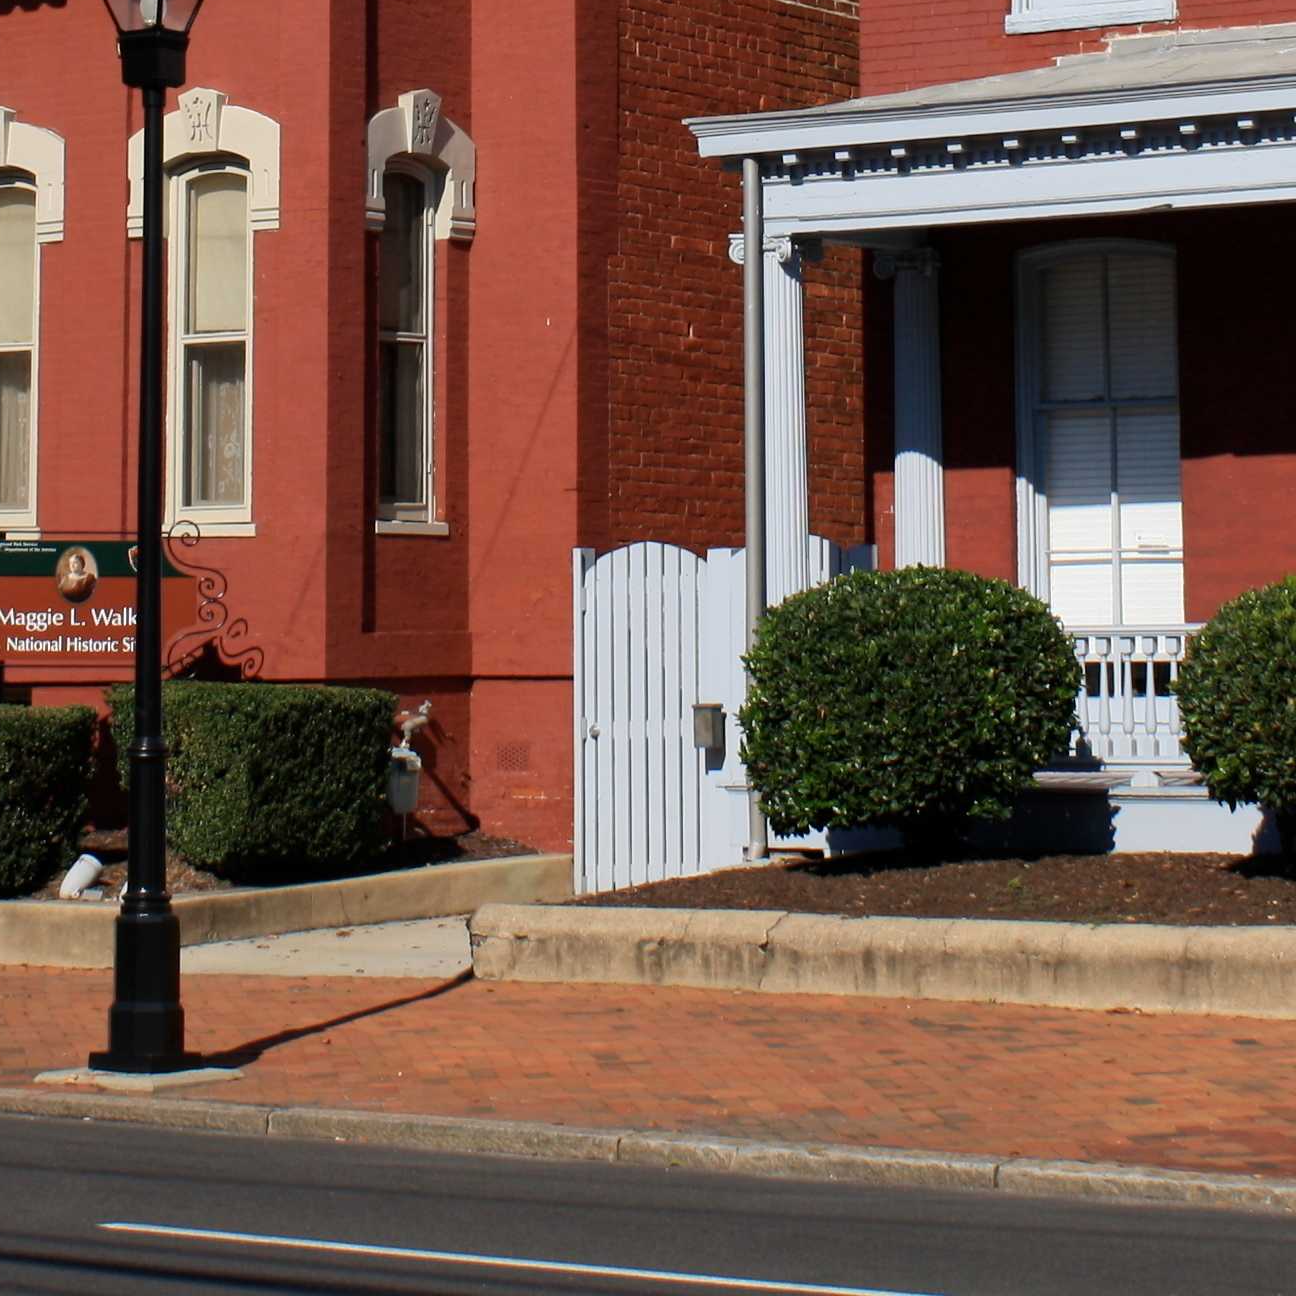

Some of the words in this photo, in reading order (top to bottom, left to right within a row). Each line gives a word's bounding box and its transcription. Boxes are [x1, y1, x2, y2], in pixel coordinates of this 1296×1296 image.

[70, 608, 86, 626] L.
[6, 635, 62, 652] National
[66, 636, 119, 652] Historic
[122, 636, 136, 652] Si
